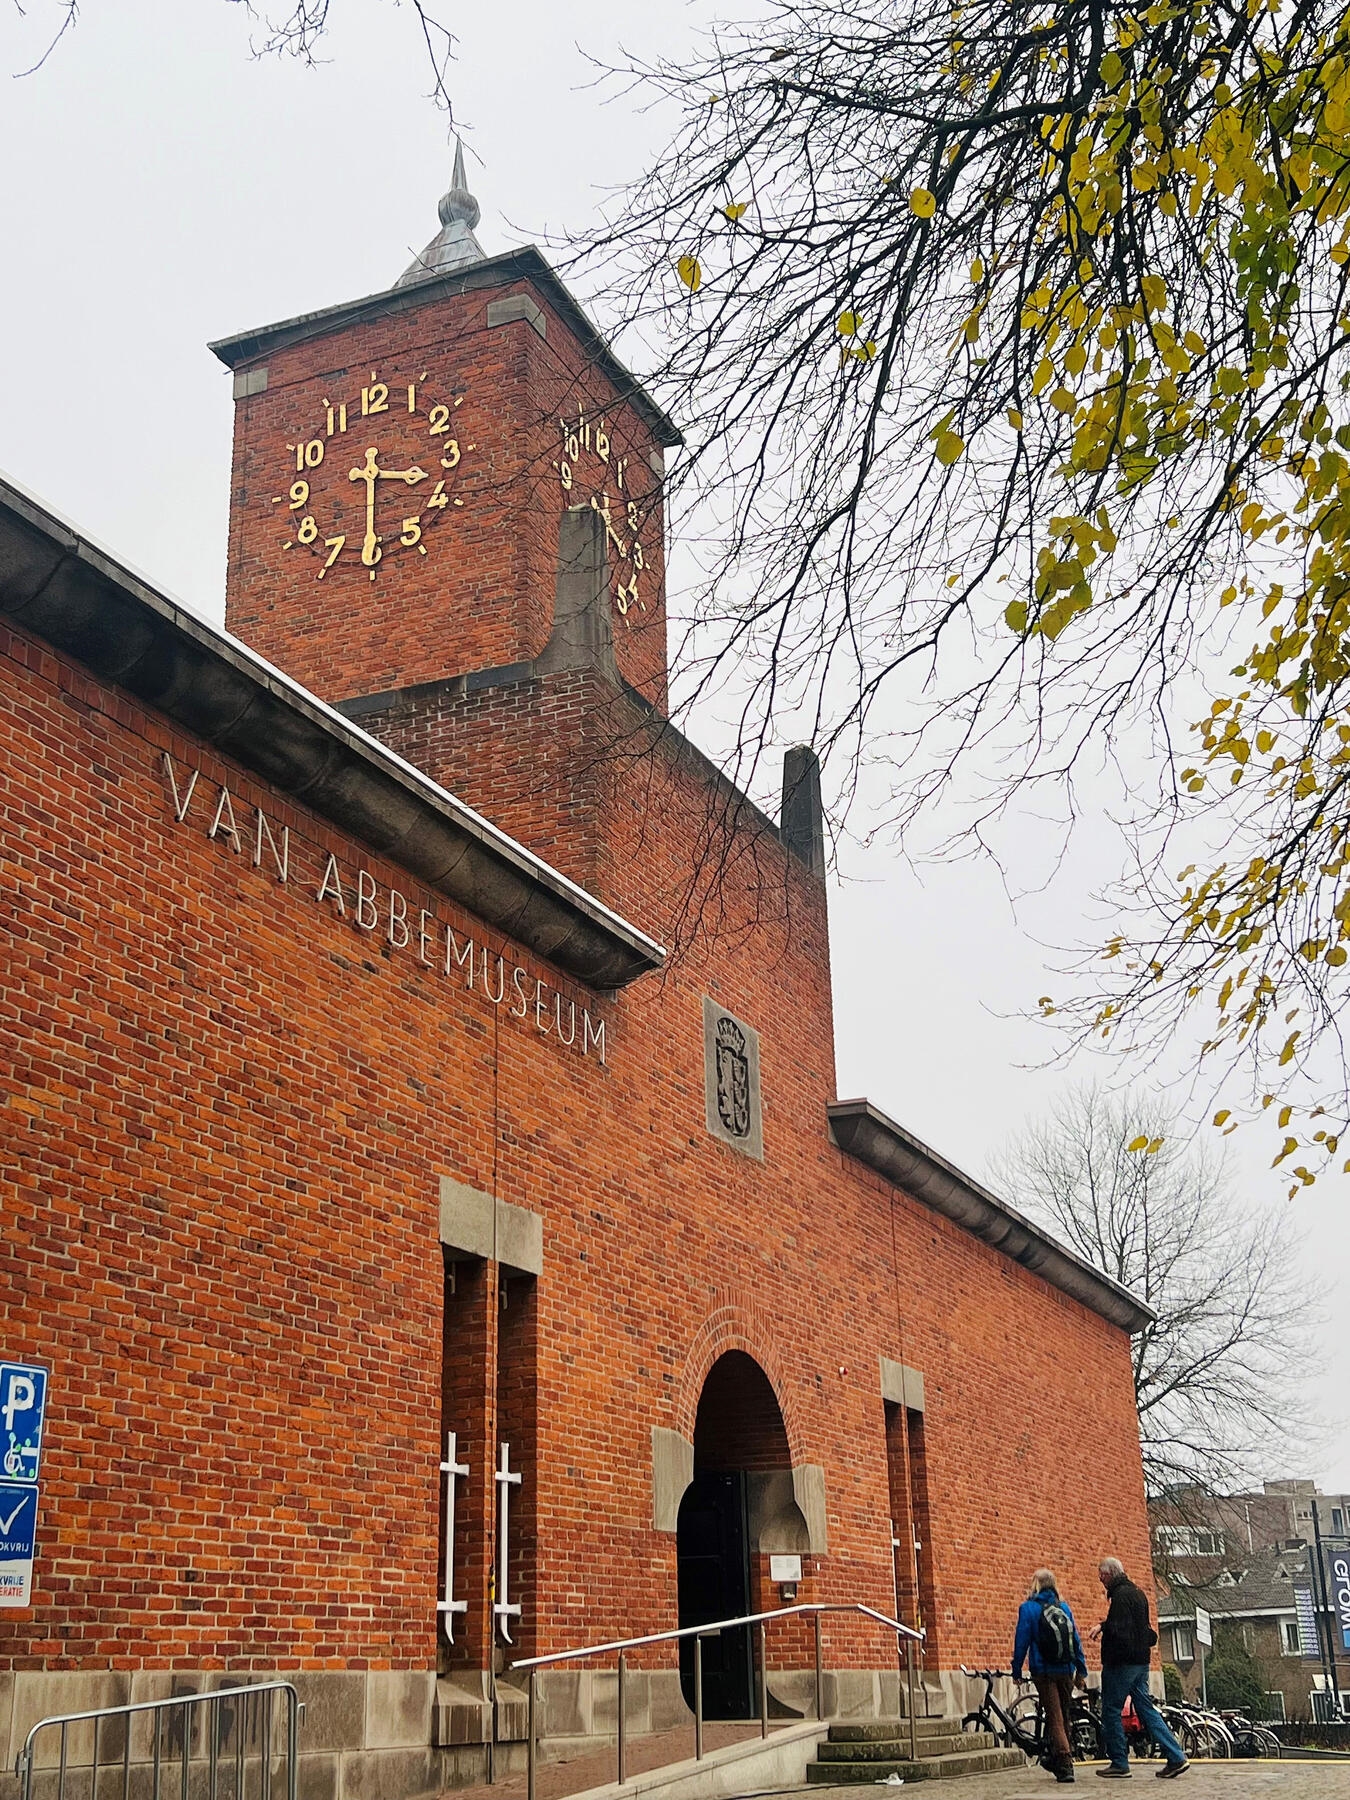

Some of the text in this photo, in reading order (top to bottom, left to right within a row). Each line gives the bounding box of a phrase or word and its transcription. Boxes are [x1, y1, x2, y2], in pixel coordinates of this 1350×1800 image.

[361, 383, 389, 416] 12
[407, 384, 416, 413] 1
[327, 404, 347, 436] 11
[429, 404, 450, 435] 2
[296, 439, 324, 471] 10
[440, 439, 461, 468] 3
[561, 460, 572, 490] 9
[617, 461, 623, 489] 1
[289, 480, 309, 510] 9
[426, 479, 449, 509] 4
[297, 515, 318, 544] 8
[400, 516, 421, 546] 5
[325, 535, 346, 568] 7
[617, 583, 628, 615] 5
[162, 751, 607, 1064] VAN ABBEMUSEUM
[5, 1375, 35, 1430] P
